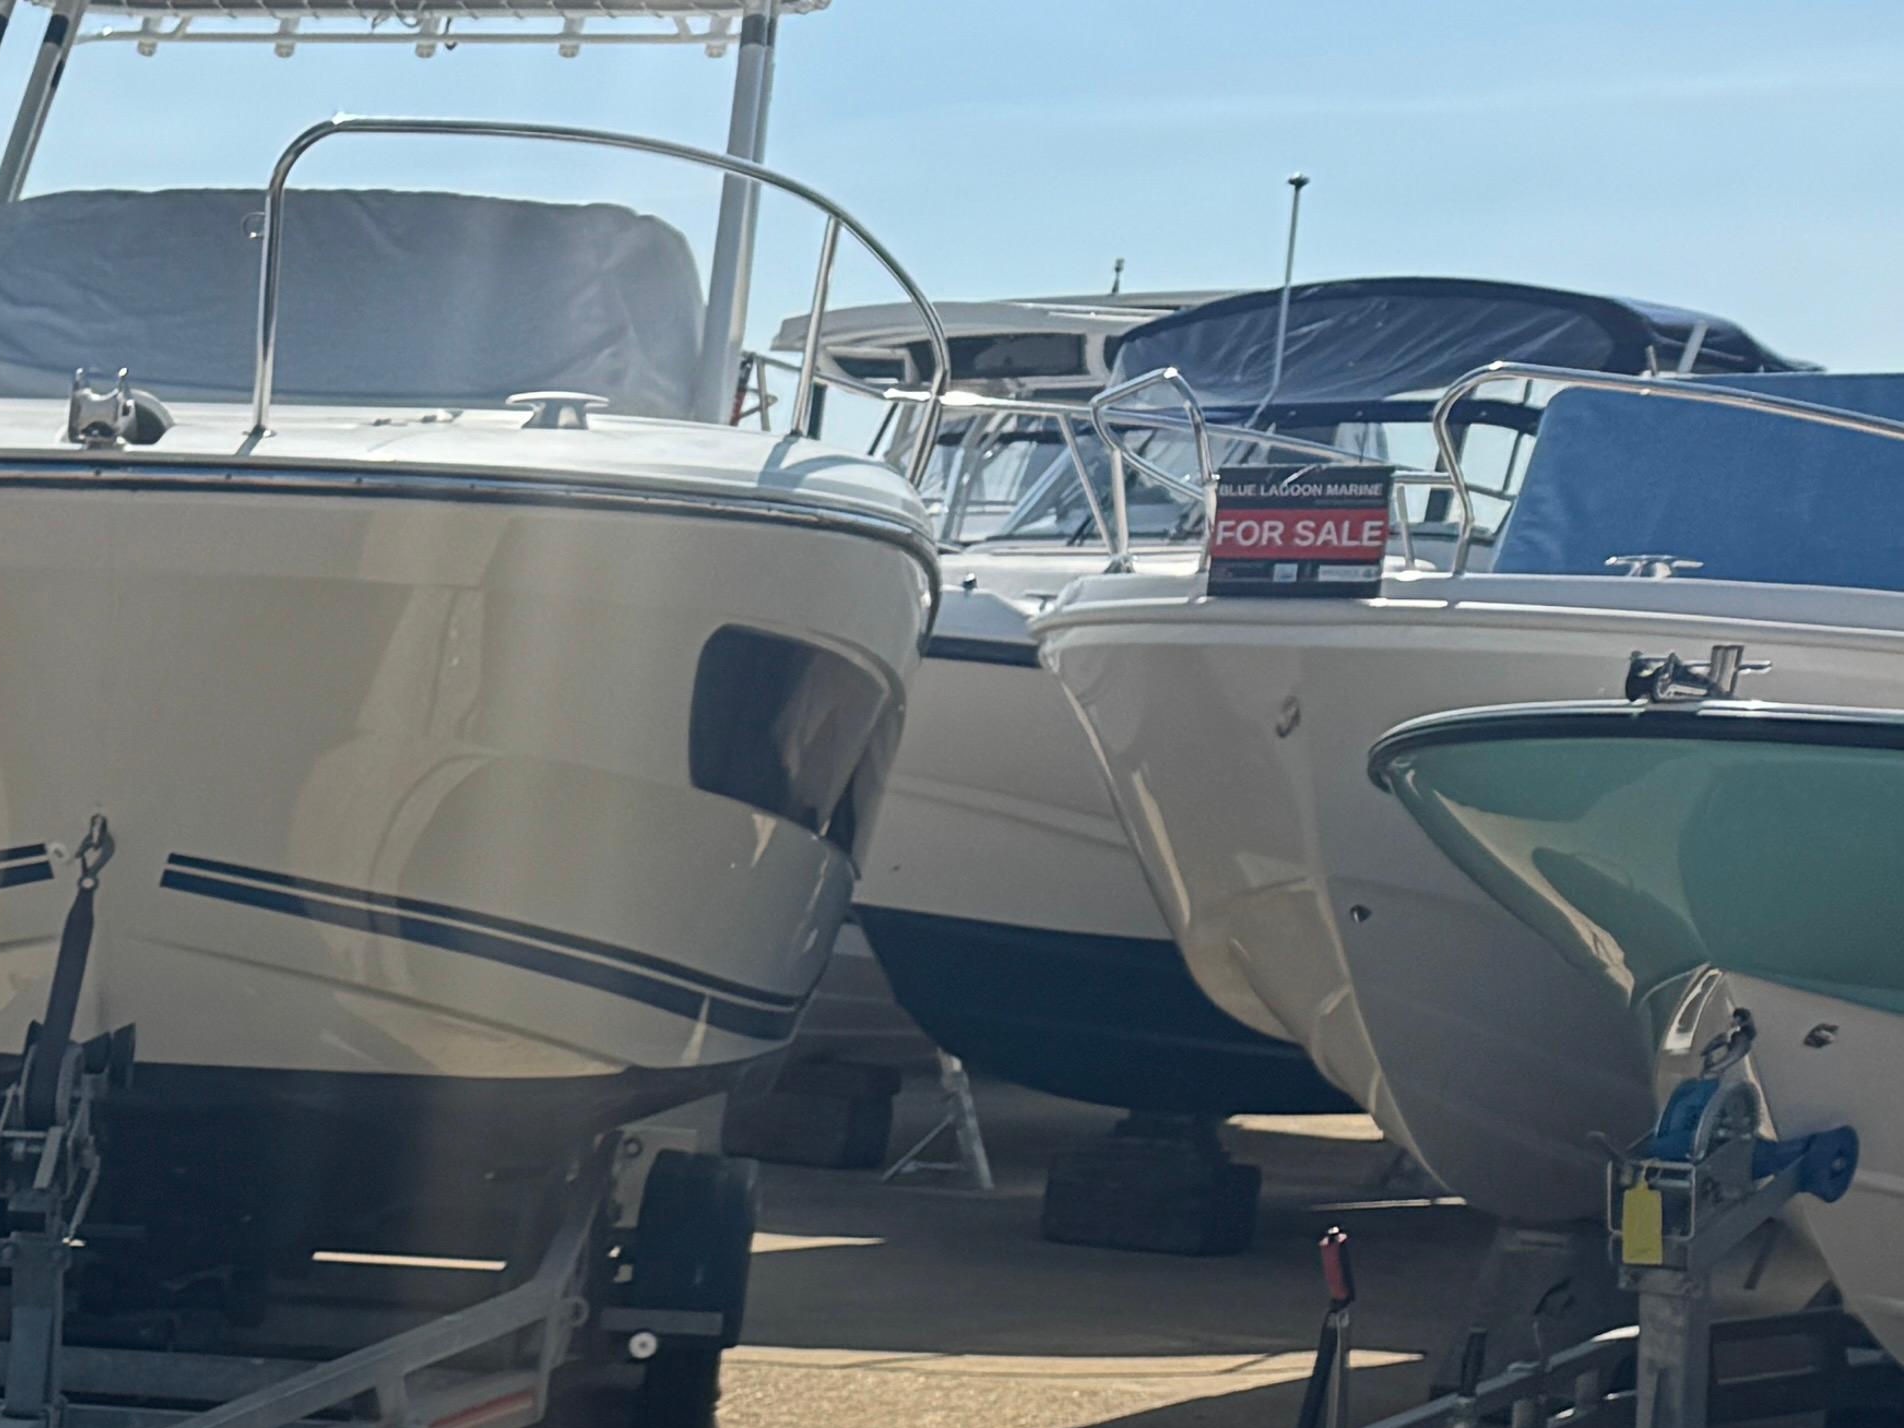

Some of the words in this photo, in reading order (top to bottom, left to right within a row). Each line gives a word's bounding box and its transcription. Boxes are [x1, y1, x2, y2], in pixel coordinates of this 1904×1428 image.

[1219, 484, 1257, 497] BLUE
[1260, 484, 1322, 497] LAGOON
[1326, 483, 1383, 497] MARINE
[1215, 520, 1285, 546] FOR
[1294, 519, 1384, 547] SALE
